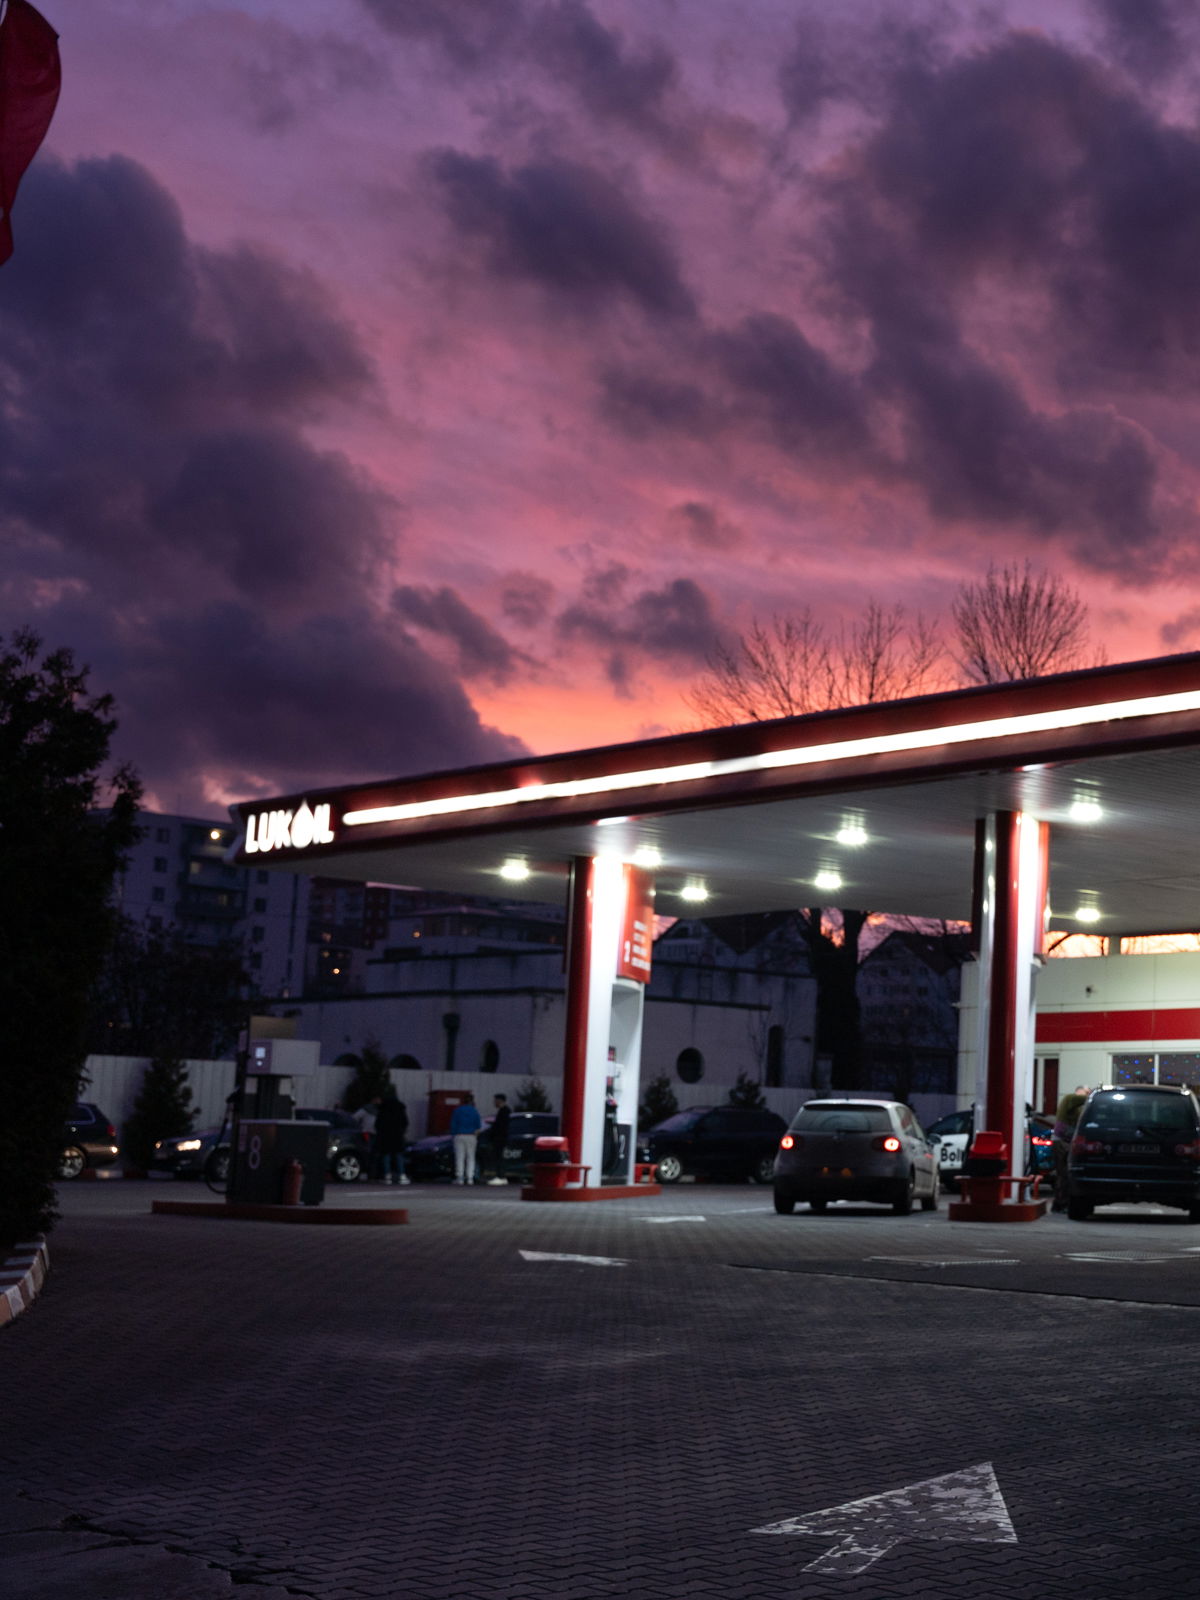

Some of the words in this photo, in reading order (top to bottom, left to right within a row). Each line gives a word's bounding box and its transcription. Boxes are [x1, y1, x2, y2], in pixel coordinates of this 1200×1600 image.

[245, 799, 335, 854] LUKOIL
[249, 1135, 262, 1169] 8
[503, 1145, 522, 1159] ber
